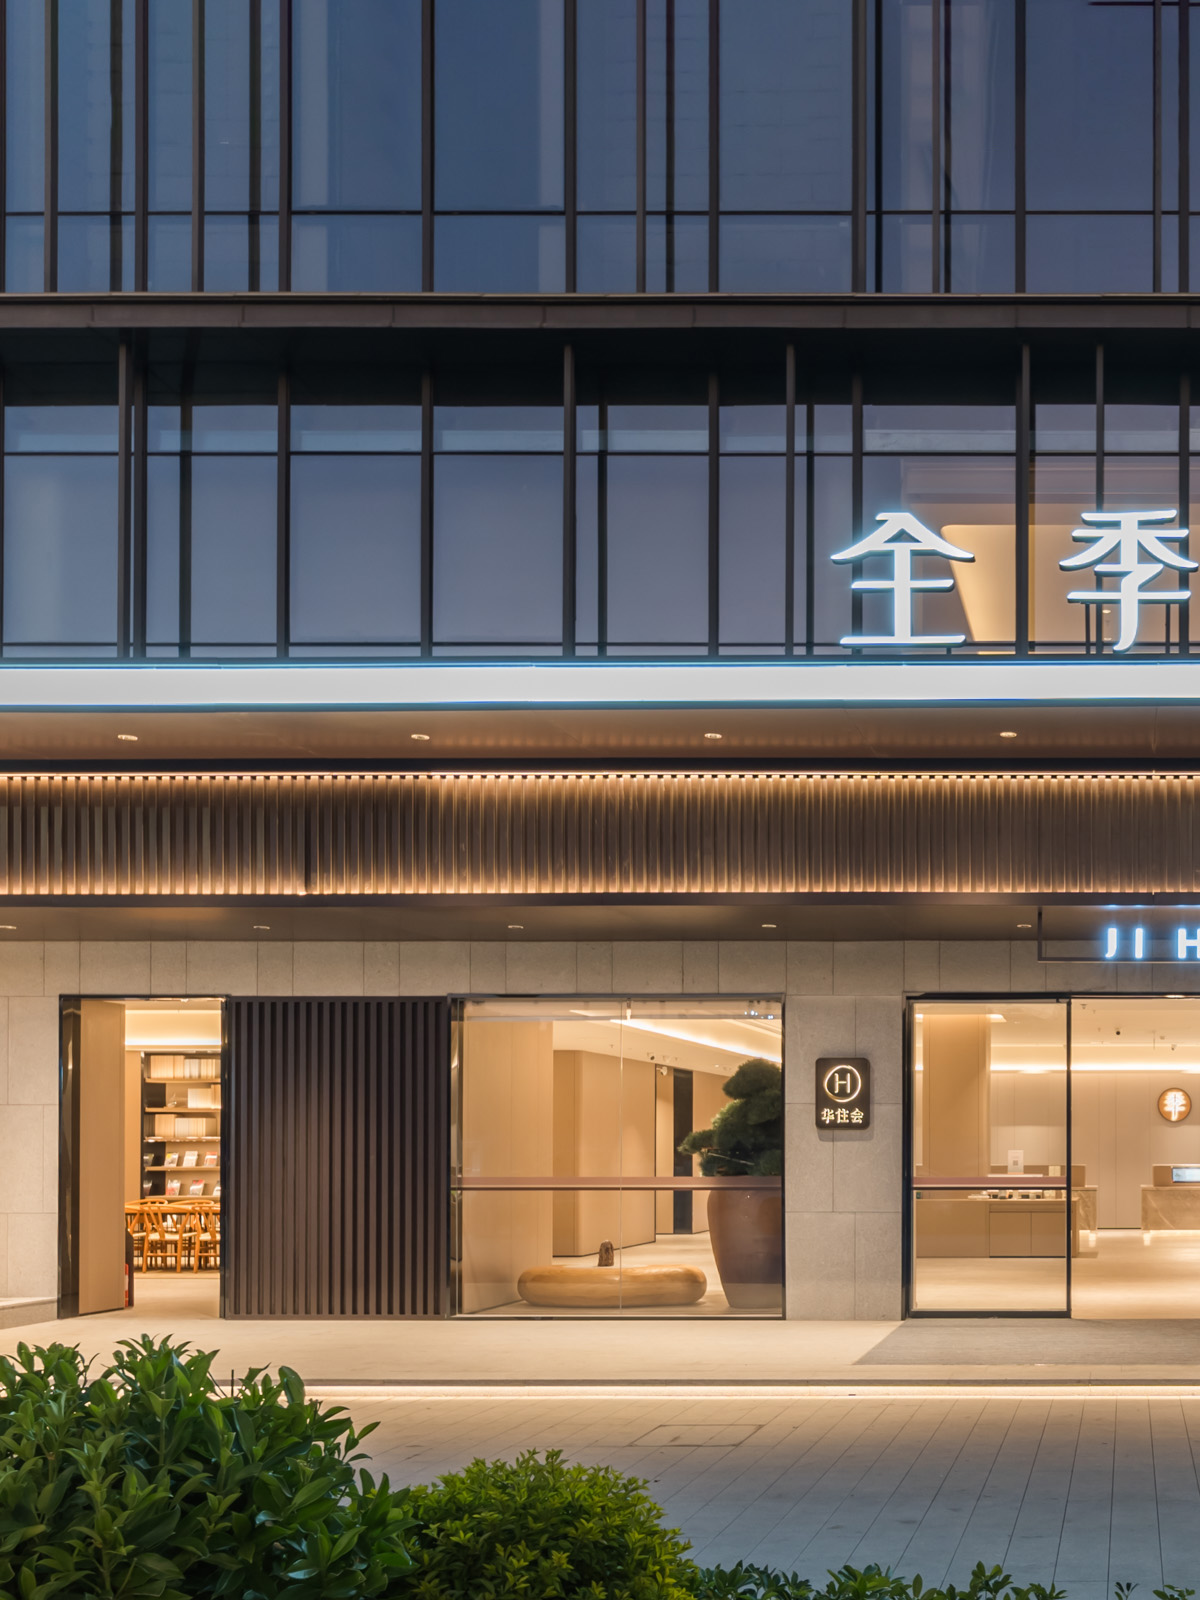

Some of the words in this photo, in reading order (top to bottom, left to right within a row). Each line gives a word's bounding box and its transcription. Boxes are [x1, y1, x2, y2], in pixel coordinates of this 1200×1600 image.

[1104, 927, 1143, 960] JI
[821, 1108, 864, 1124] 华住会
